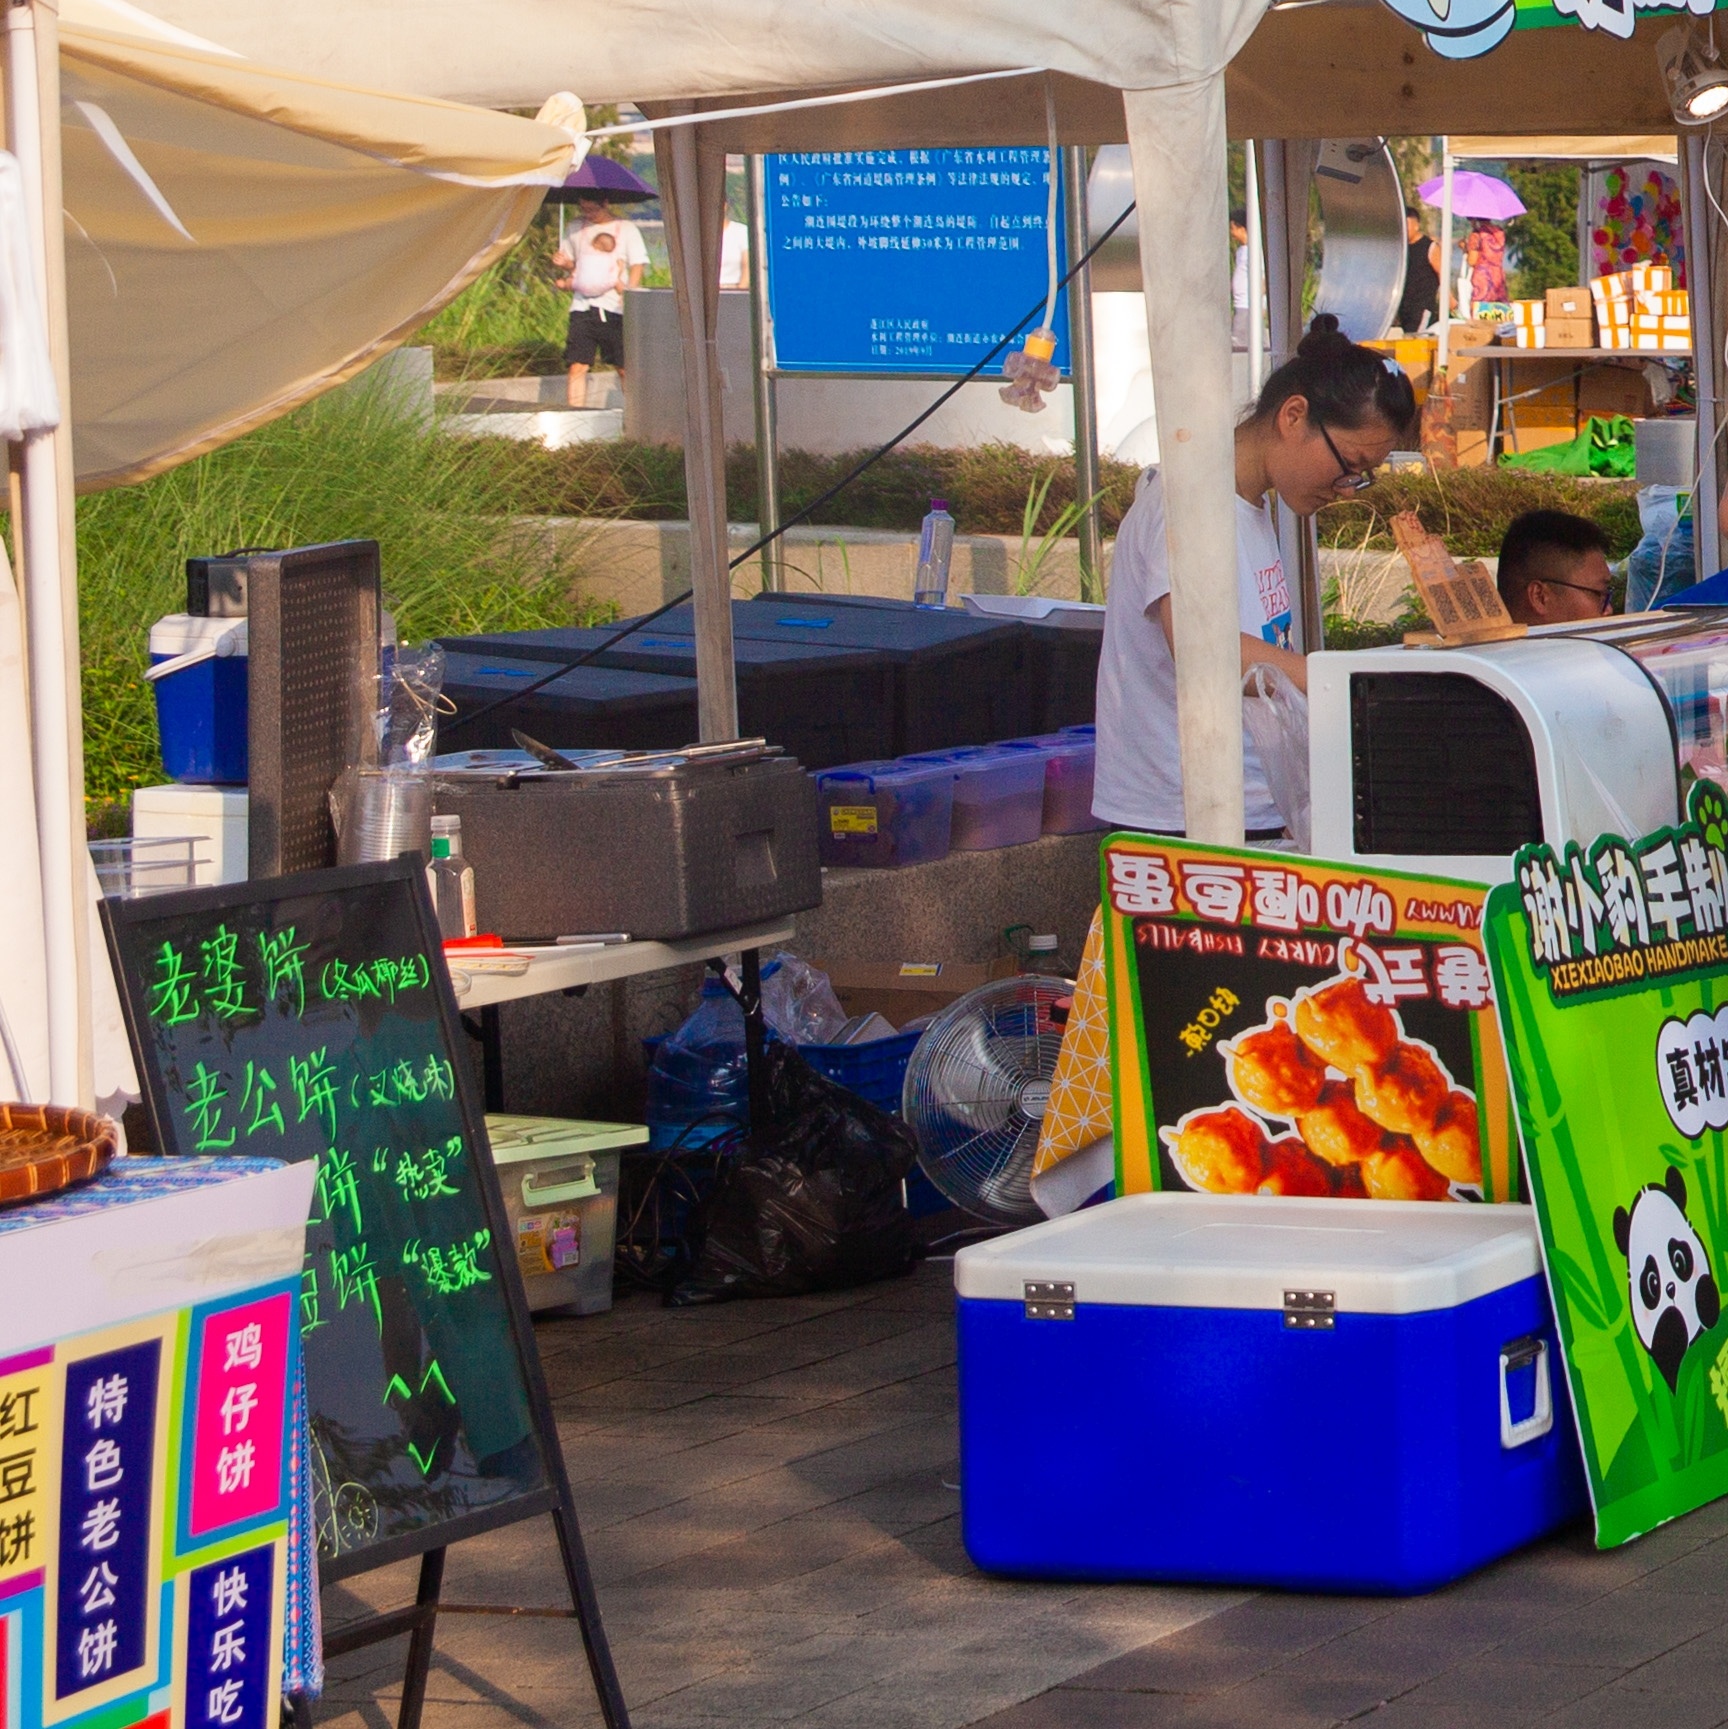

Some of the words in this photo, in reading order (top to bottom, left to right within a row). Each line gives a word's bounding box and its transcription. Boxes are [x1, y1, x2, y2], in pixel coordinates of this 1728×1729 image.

[149, 923, 311, 1027] 老婆饼
[1550, 952, 1644, 991] XIEXIAOBAO
[184, 1045, 342, 1152] 老公饼
[0, 1385, 41, 1568] 红豆饼
[214, 1321, 264, 1496] 鸡仔饼
[77, 1372, 129, 1679] 特色老公饼
[207, 1565, 250, 1723] 快乐吃
